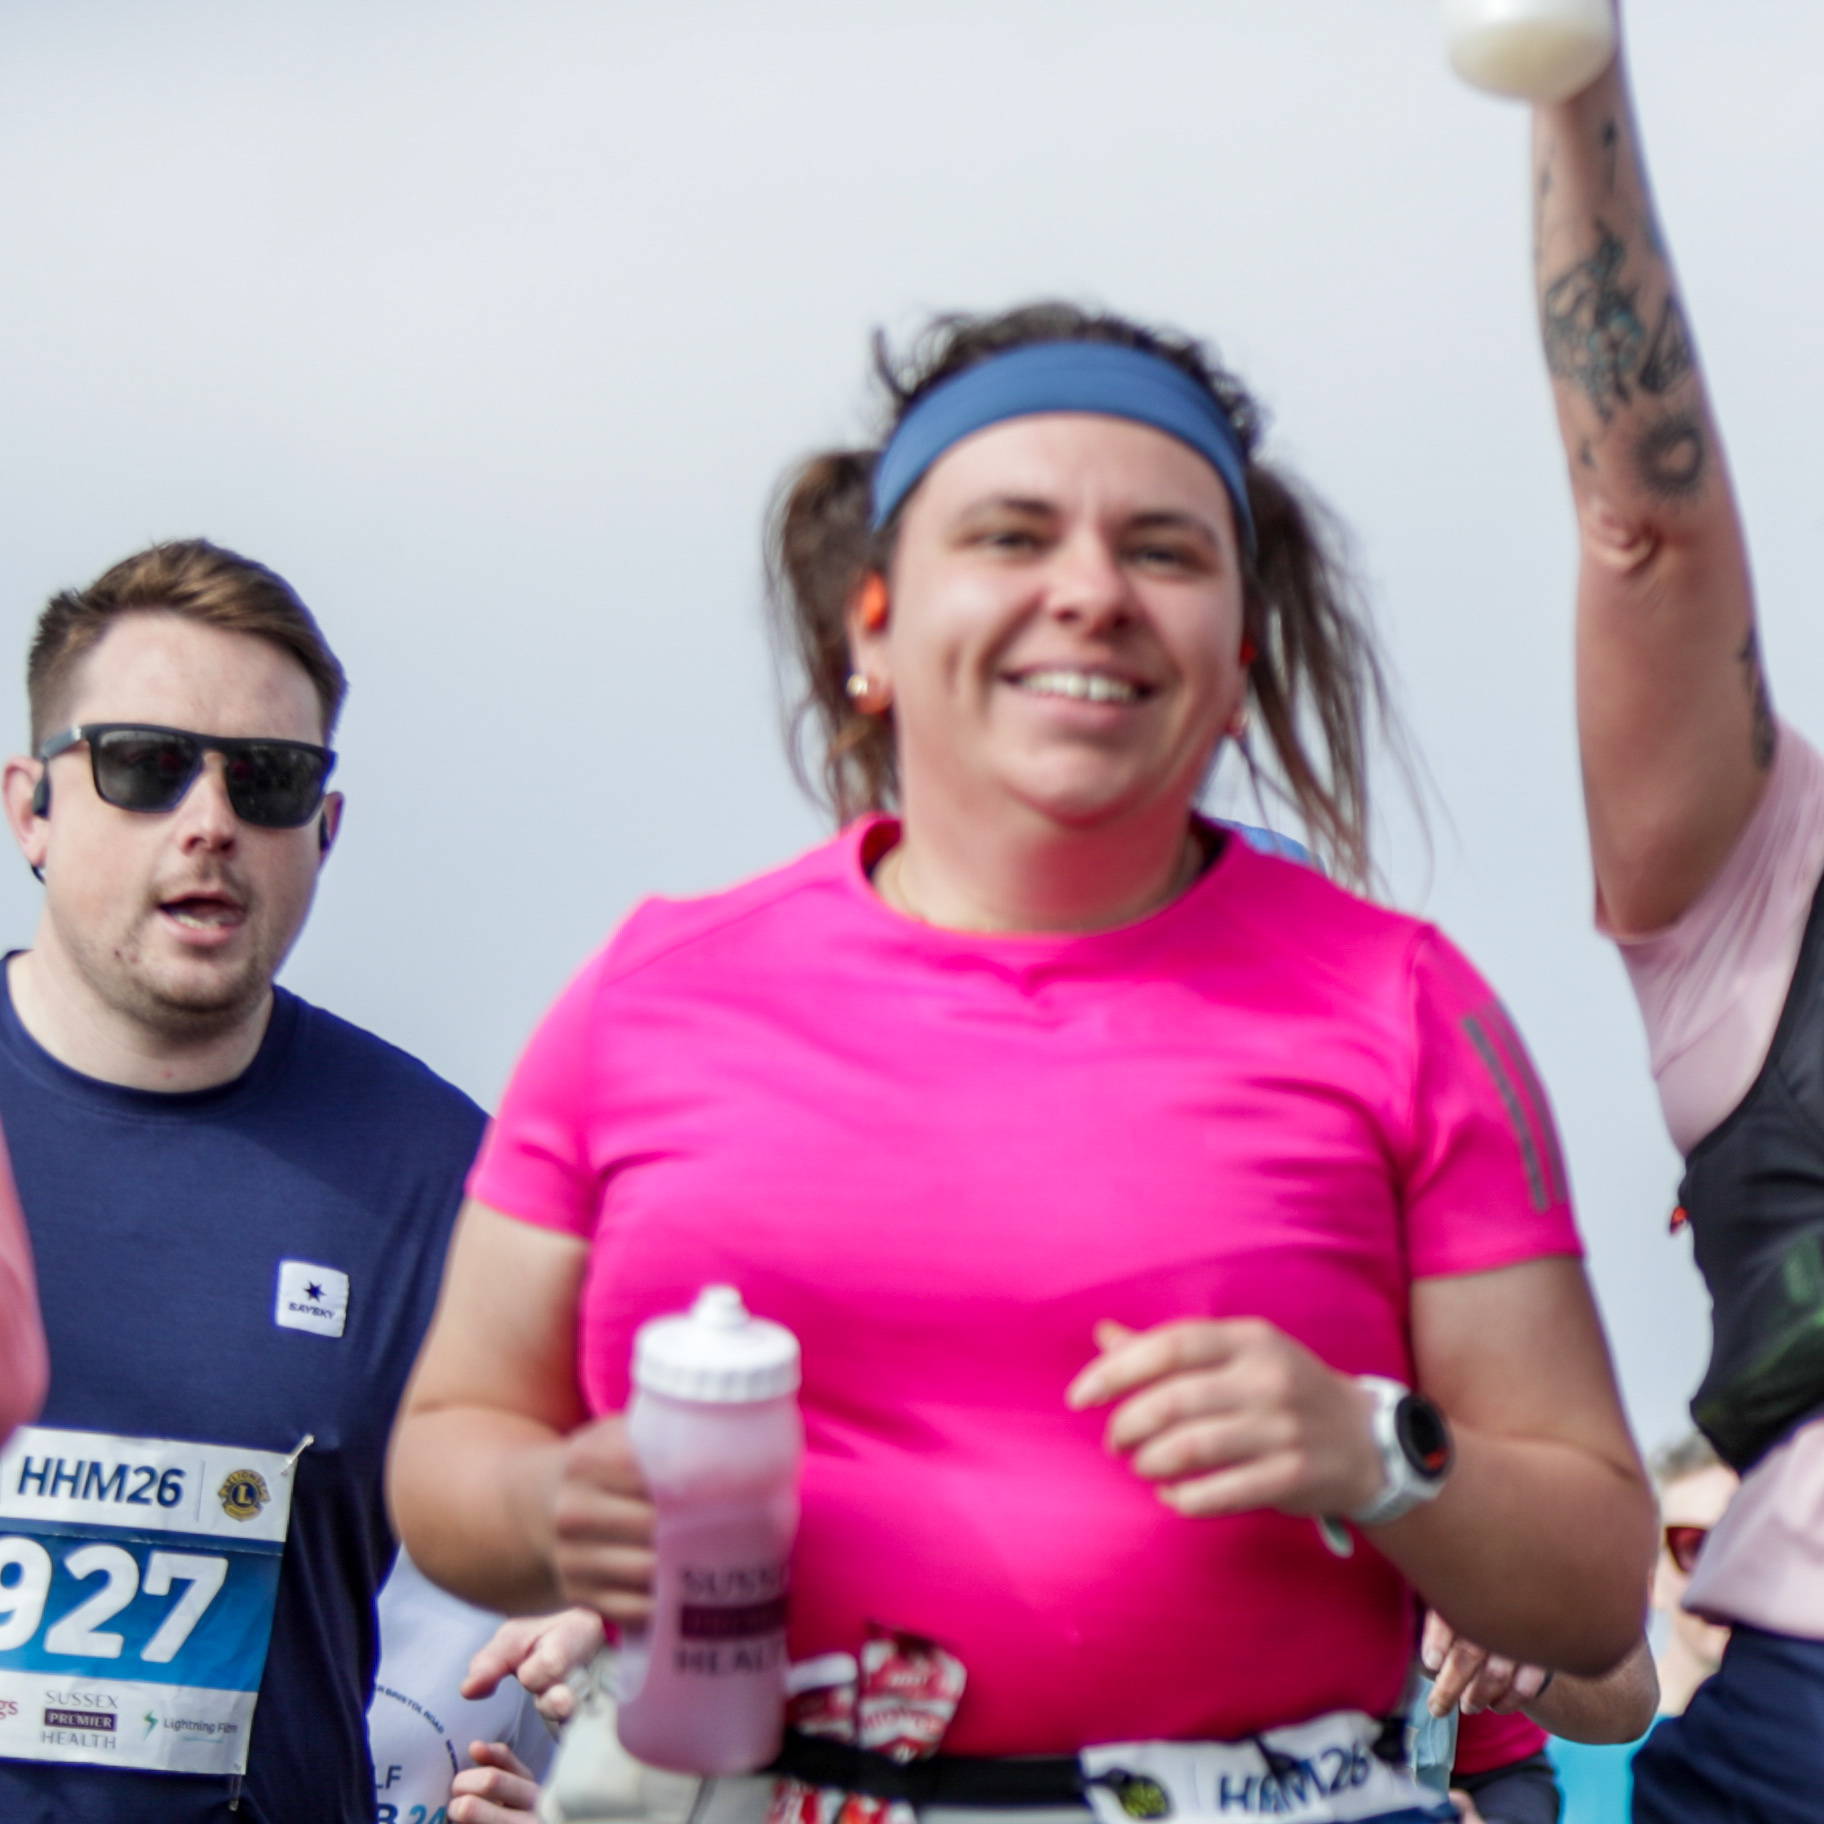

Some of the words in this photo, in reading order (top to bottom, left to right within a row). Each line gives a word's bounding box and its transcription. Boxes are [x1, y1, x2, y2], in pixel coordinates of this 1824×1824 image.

[18, 1456, 186, 1508] HHM26
[0, 1536, 229, 1663] 927
[45, 1690, 119, 1710] SUSSEX
[49, 1711, 113, 1730] PREMIER
[41, 1730, 117, 1750] HEALTH
